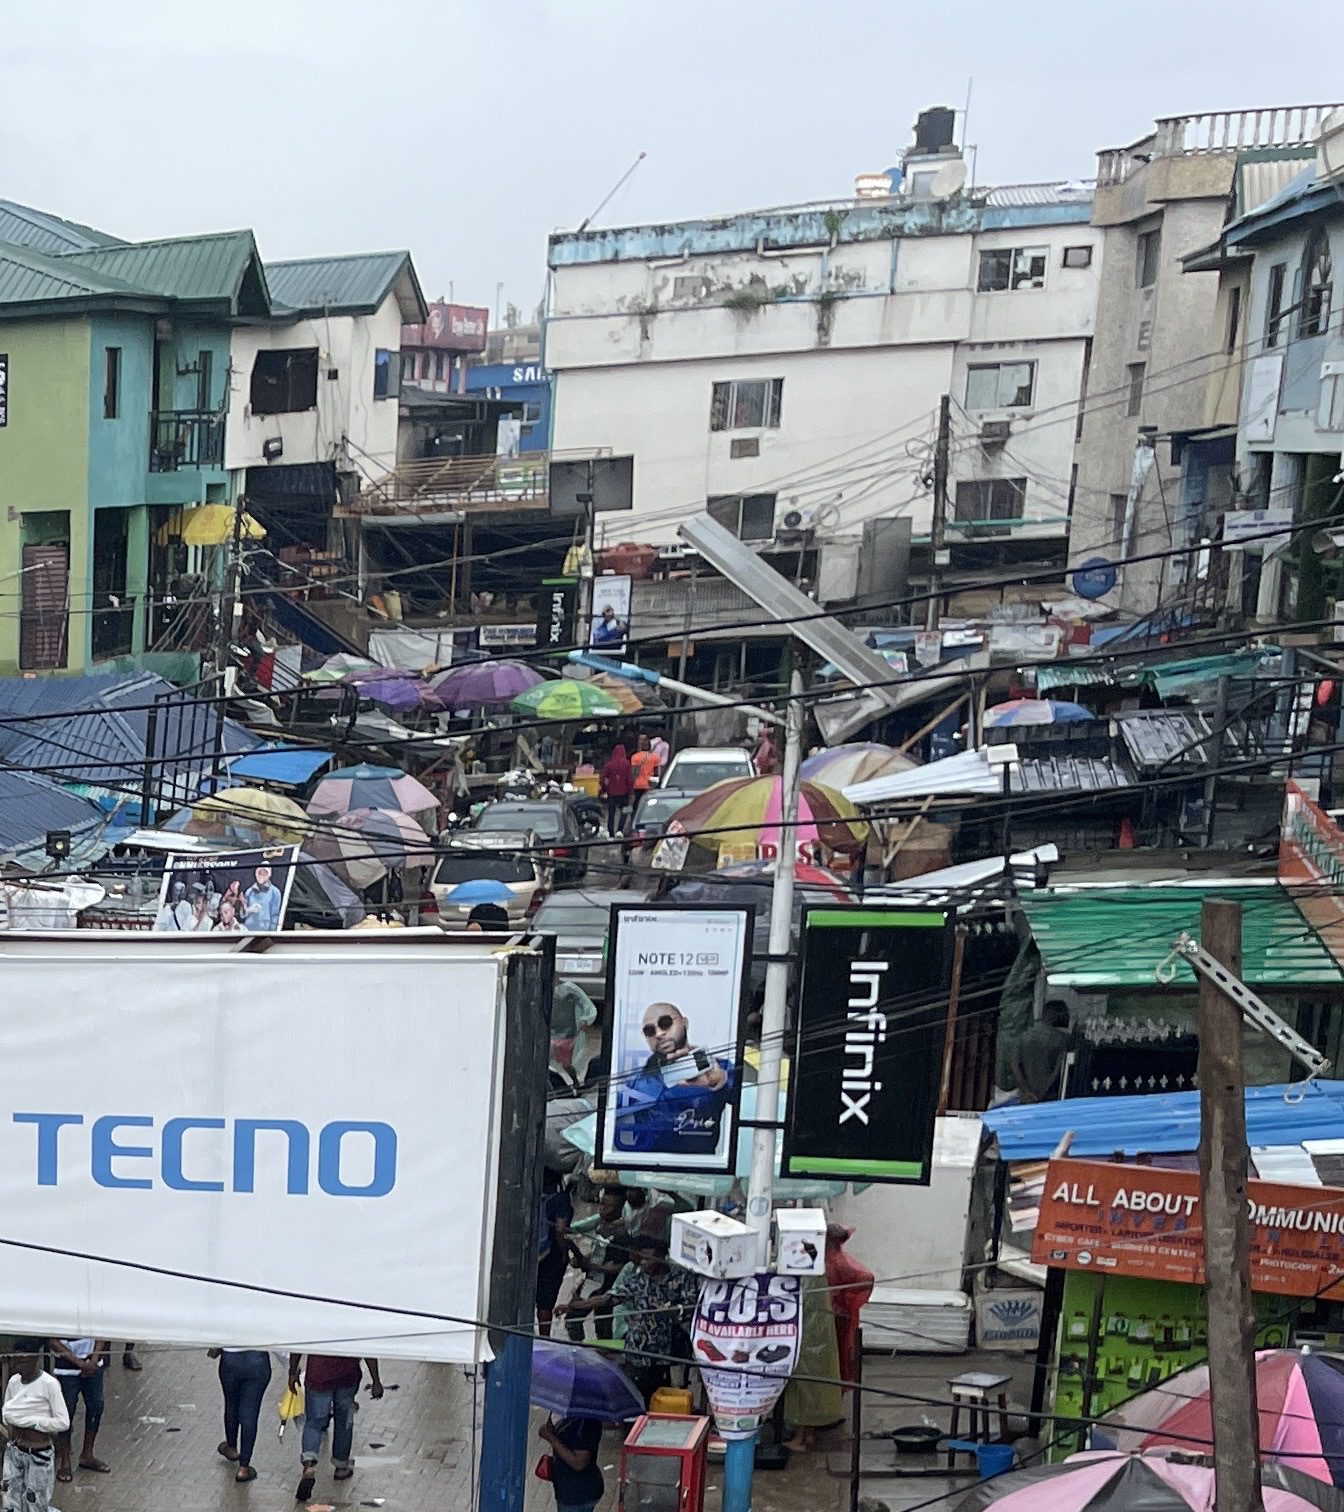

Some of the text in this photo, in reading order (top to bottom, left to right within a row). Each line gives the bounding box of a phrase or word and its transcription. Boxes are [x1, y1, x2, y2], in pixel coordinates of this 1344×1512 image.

[638, 952, 694, 966] NOTE 12
[839, 961, 889, 1125] Infinix
[12, 1112, 398, 1198] TECNO
[1052, 1180, 1199, 1217] ALL ABOUT
[709, 1323, 764, 1338] AVAILABLE
[765, 1323, 795, 1337] HERE
